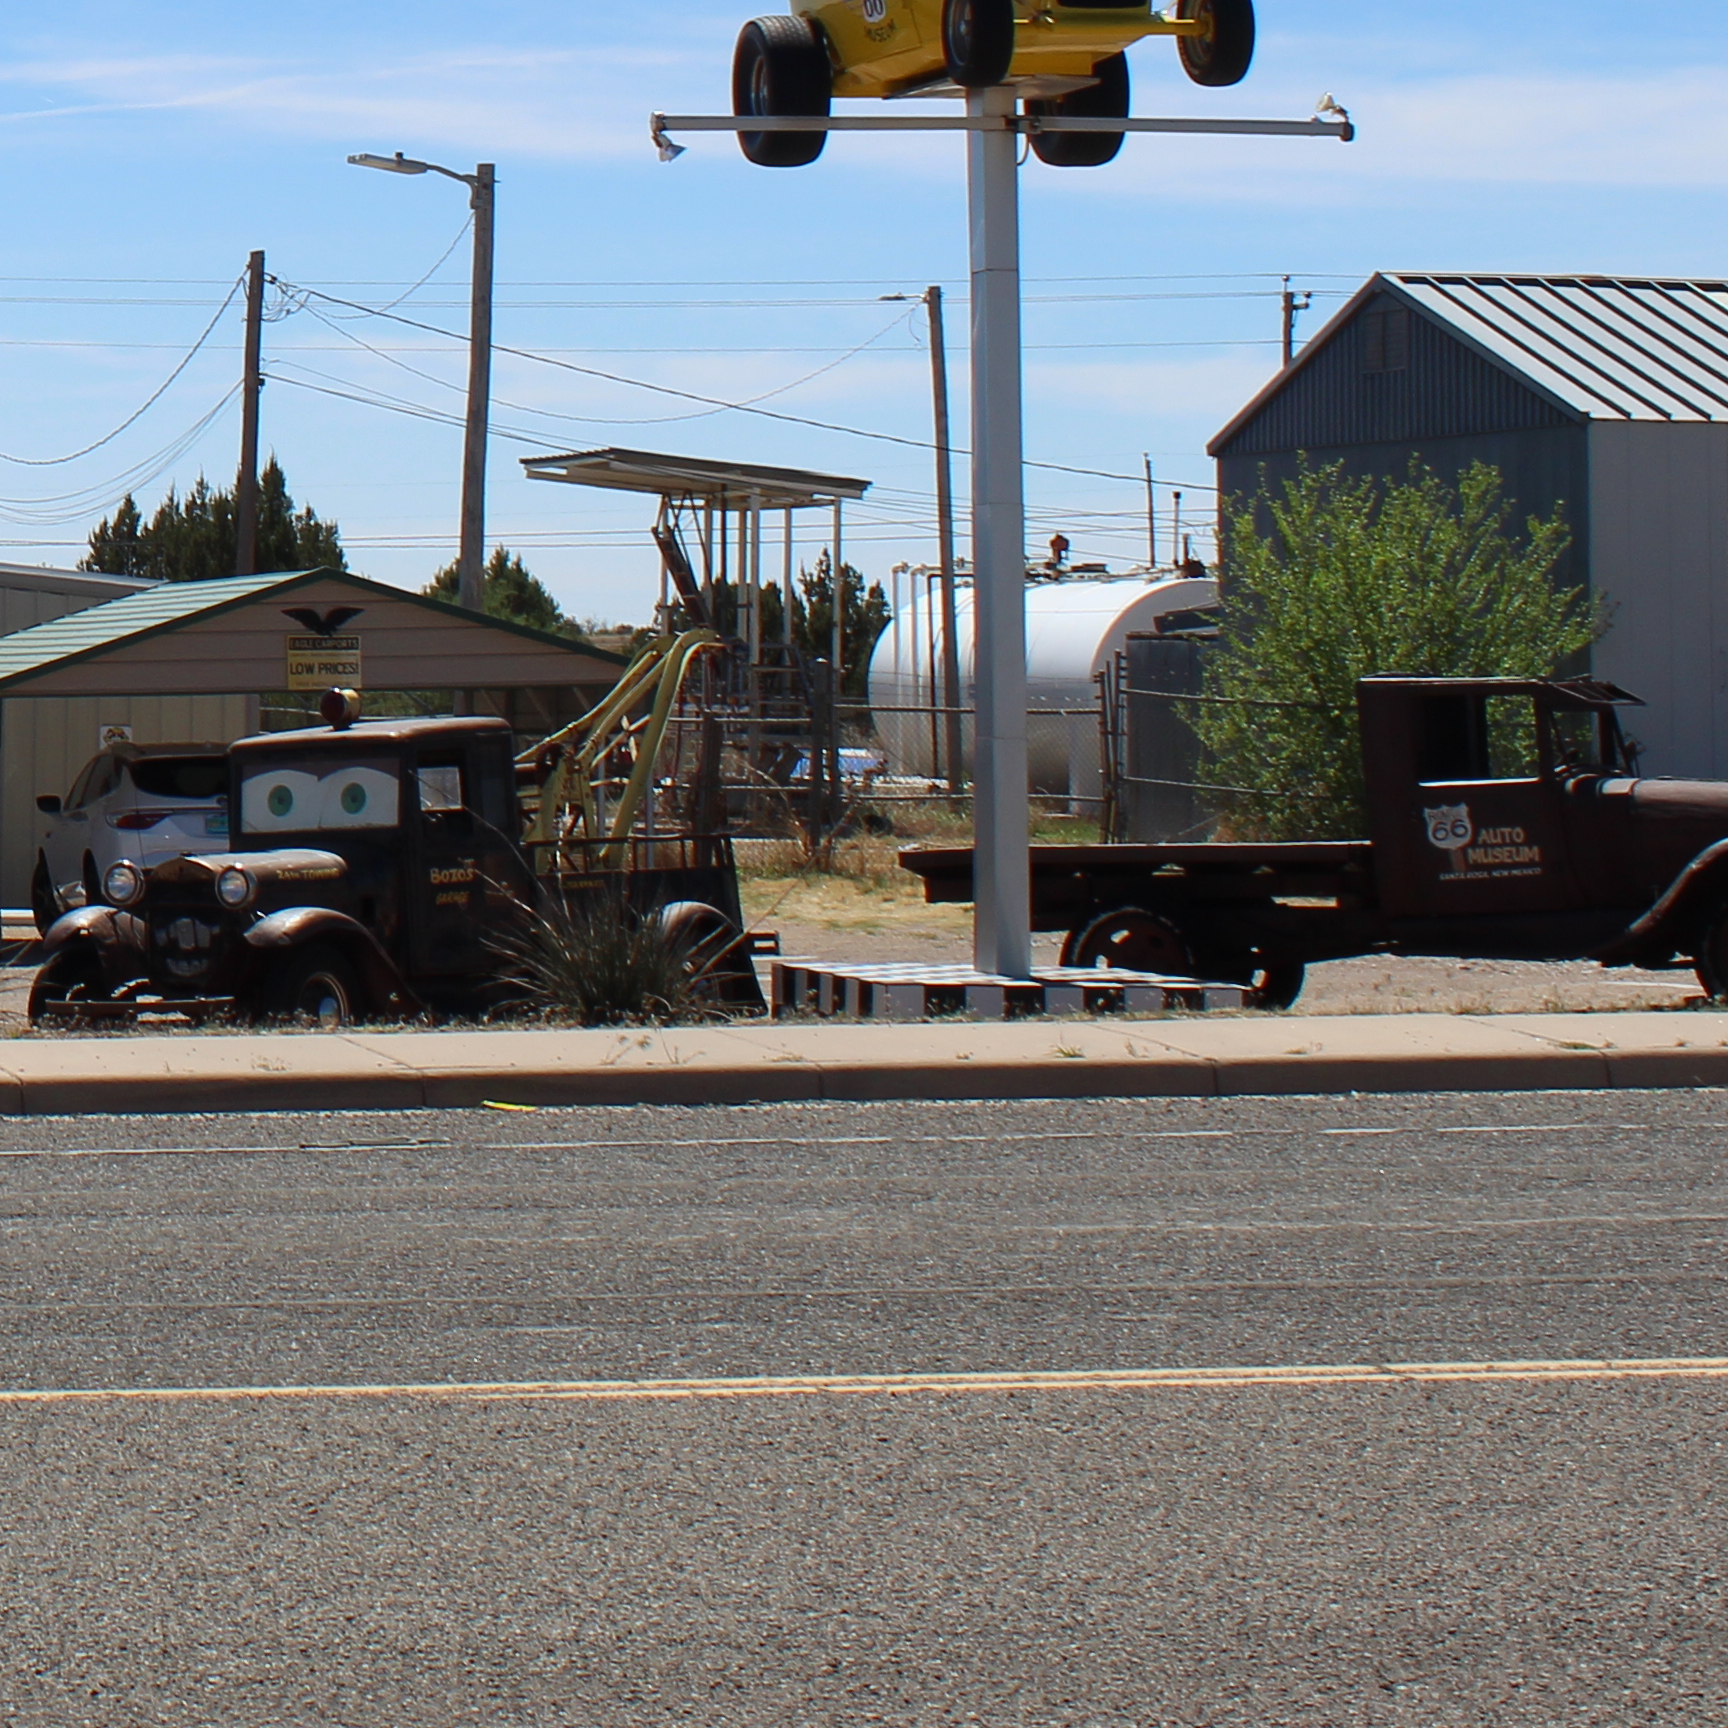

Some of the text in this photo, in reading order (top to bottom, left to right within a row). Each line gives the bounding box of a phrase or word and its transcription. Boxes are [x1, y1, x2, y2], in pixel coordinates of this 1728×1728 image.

[865, 18, 894, 42] MUSEUM
[290, 638, 358, 648] EAGLE CARPORTS
[290, 661, 359, 675] LOW PRICES!
[1432, 818, 1468, 841] 66
[1478, 826, 1525, 845] AUTO
[1466, 845, 1541, 864] MUSEUM
[430, 868, 474, 883] BOZOS
[1491, 868, 1509, 877] NEW
[1510, 867, 1542, 876] MEXICO
